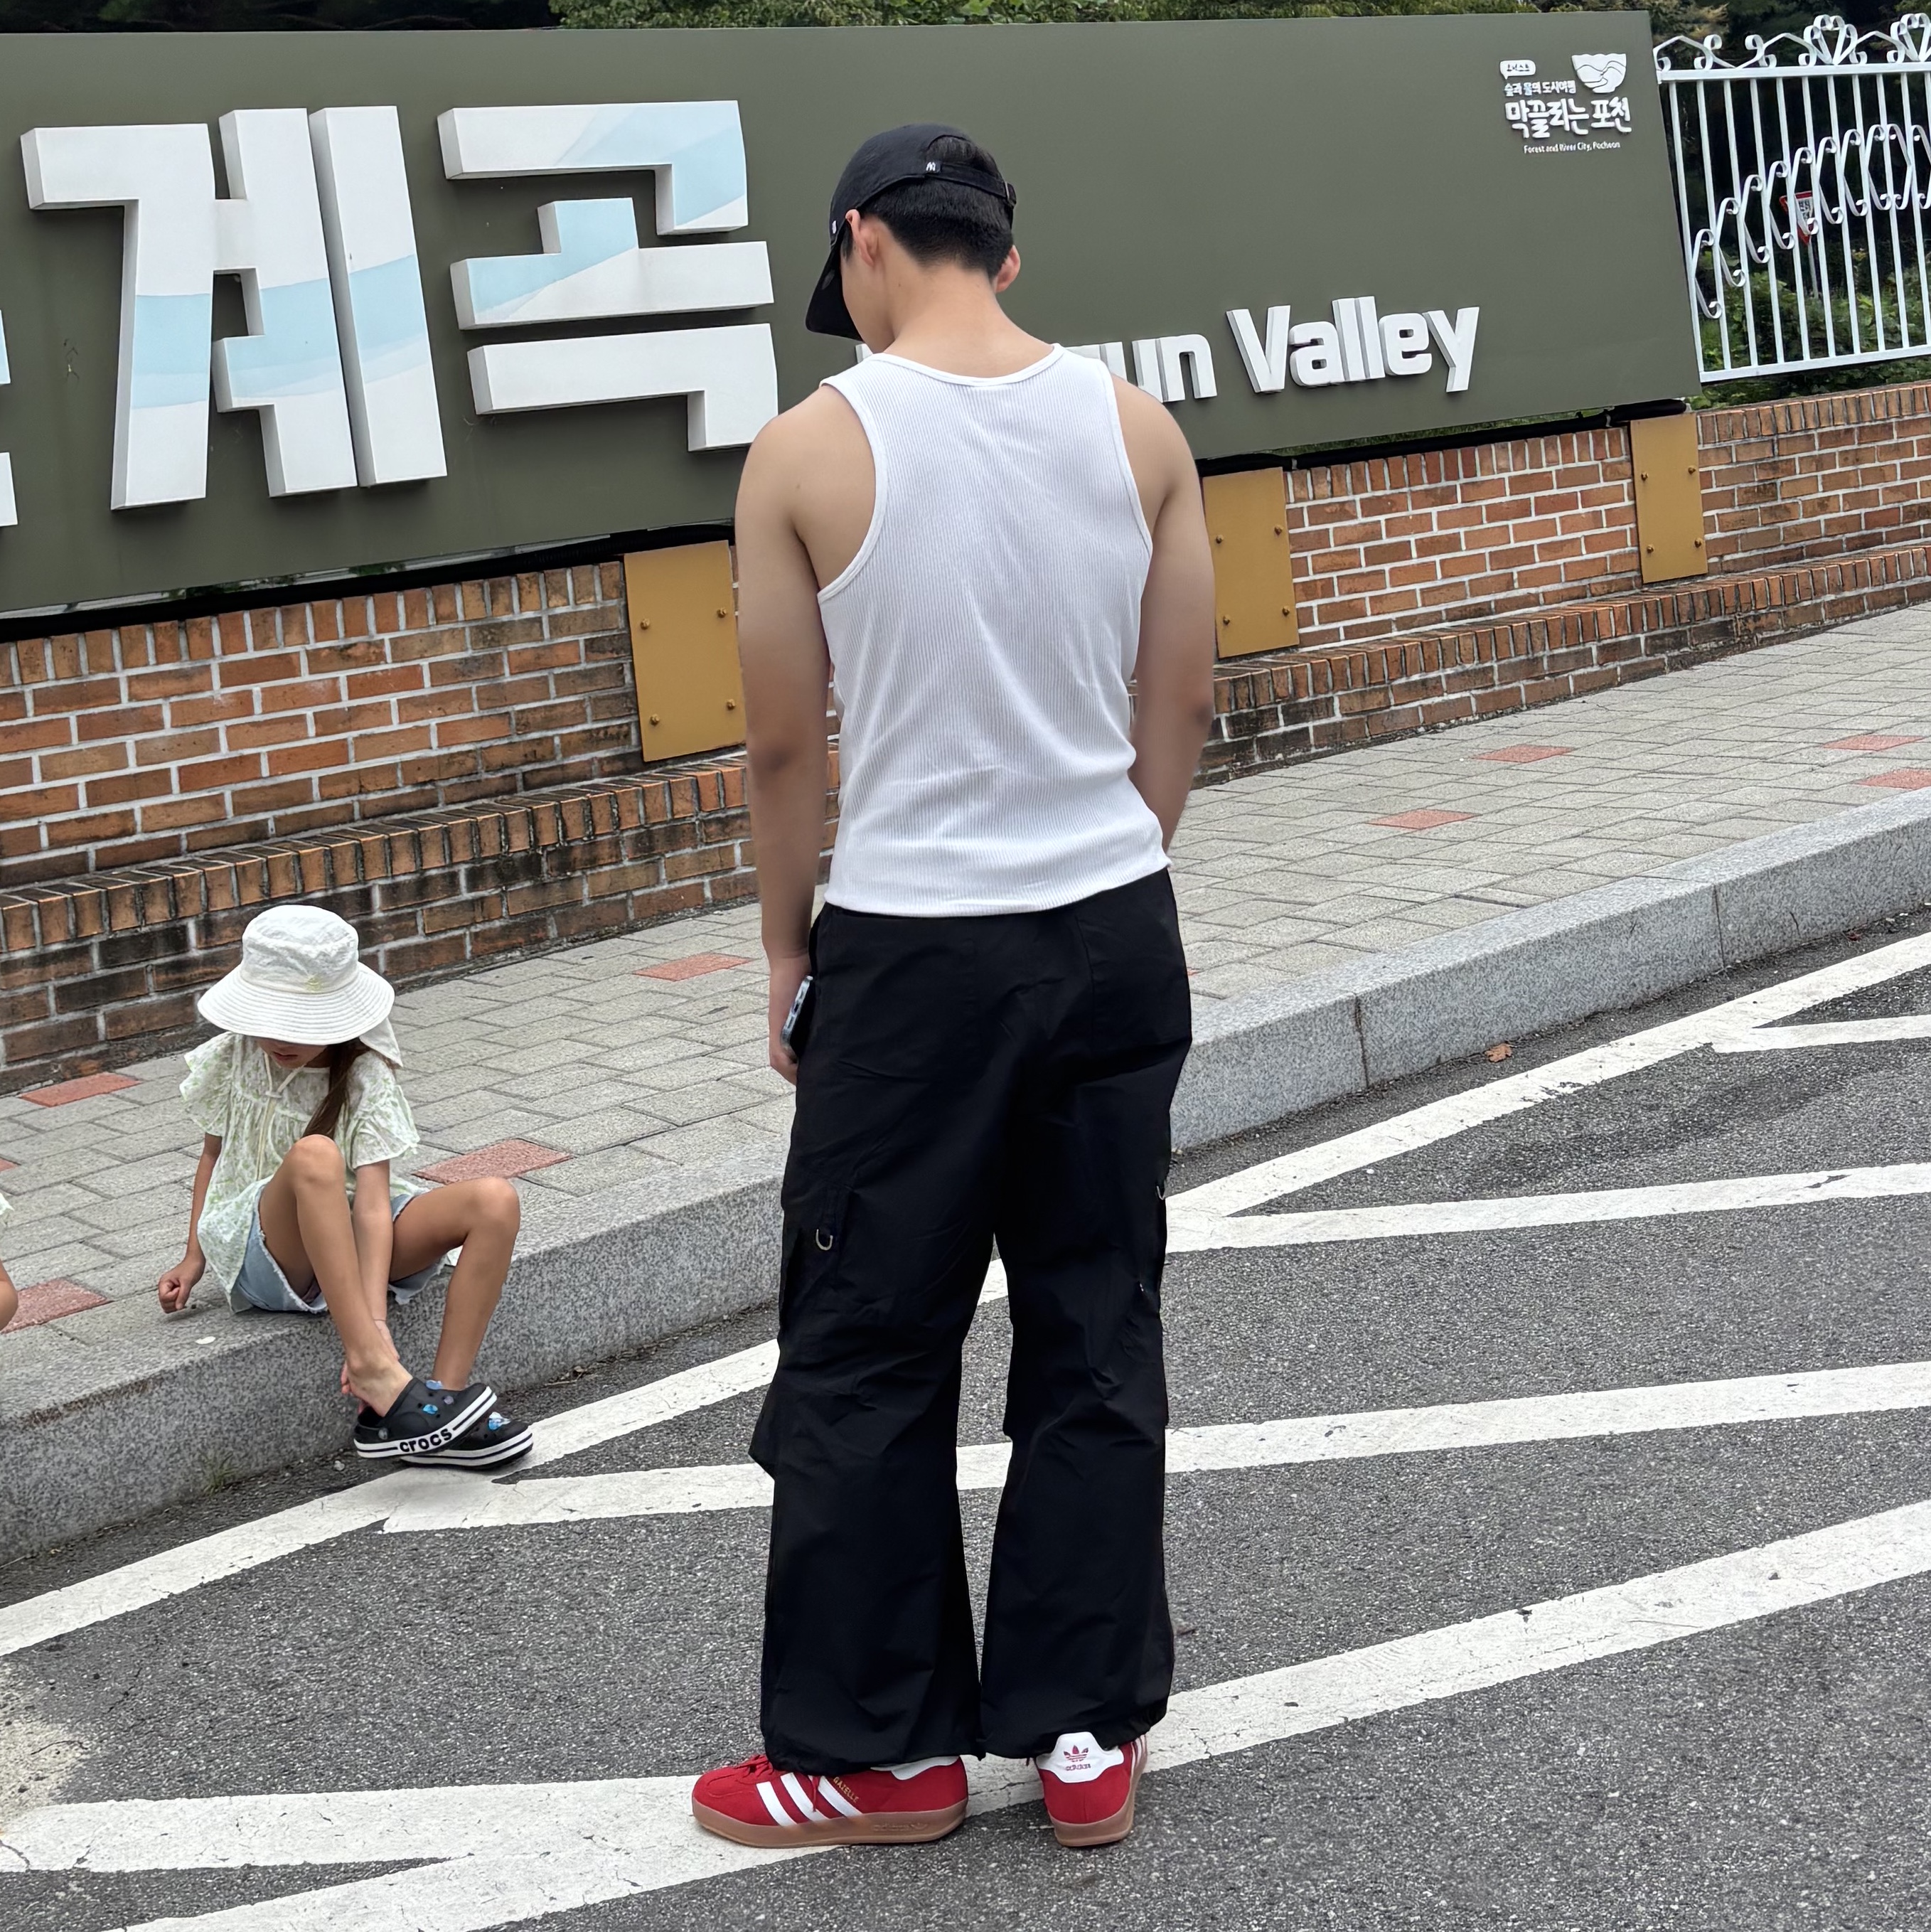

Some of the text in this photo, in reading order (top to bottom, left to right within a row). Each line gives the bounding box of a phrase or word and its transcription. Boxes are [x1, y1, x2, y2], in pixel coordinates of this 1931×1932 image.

[1590, 96, 1632, 133] 포천
[1524, 144, 1545, 154] Forest
[1546, 144, 1558, 152] and
[0, 99, 779, 528] 계곡
[1226, 295, 1480, 393] Valley
[833, 1776, 860, 1803] GAZELLE
